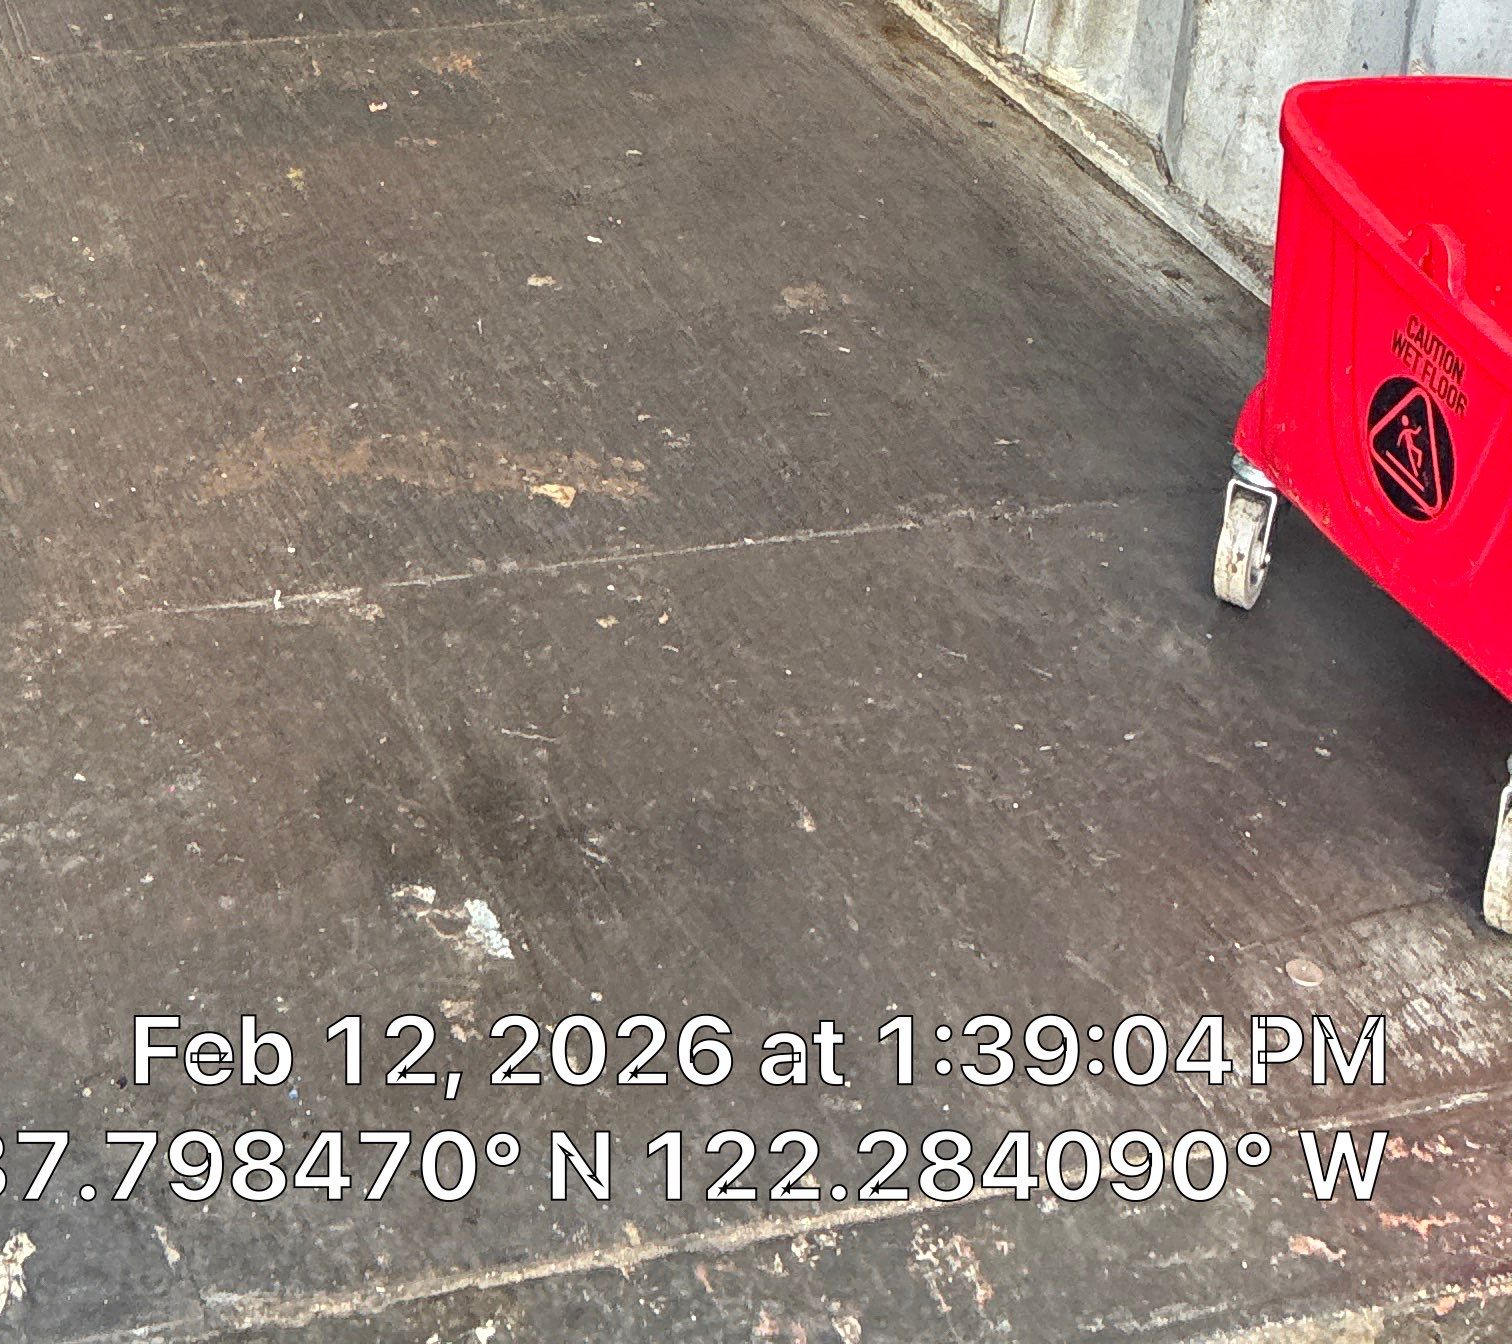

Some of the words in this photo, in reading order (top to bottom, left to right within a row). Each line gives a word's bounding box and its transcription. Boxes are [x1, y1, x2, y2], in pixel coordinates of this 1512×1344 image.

[1392, 328, 1423, 373] WET
[1421, 359, 1467, 419] FLOOR
[1407, 314, 1465, 385] CAUTION
